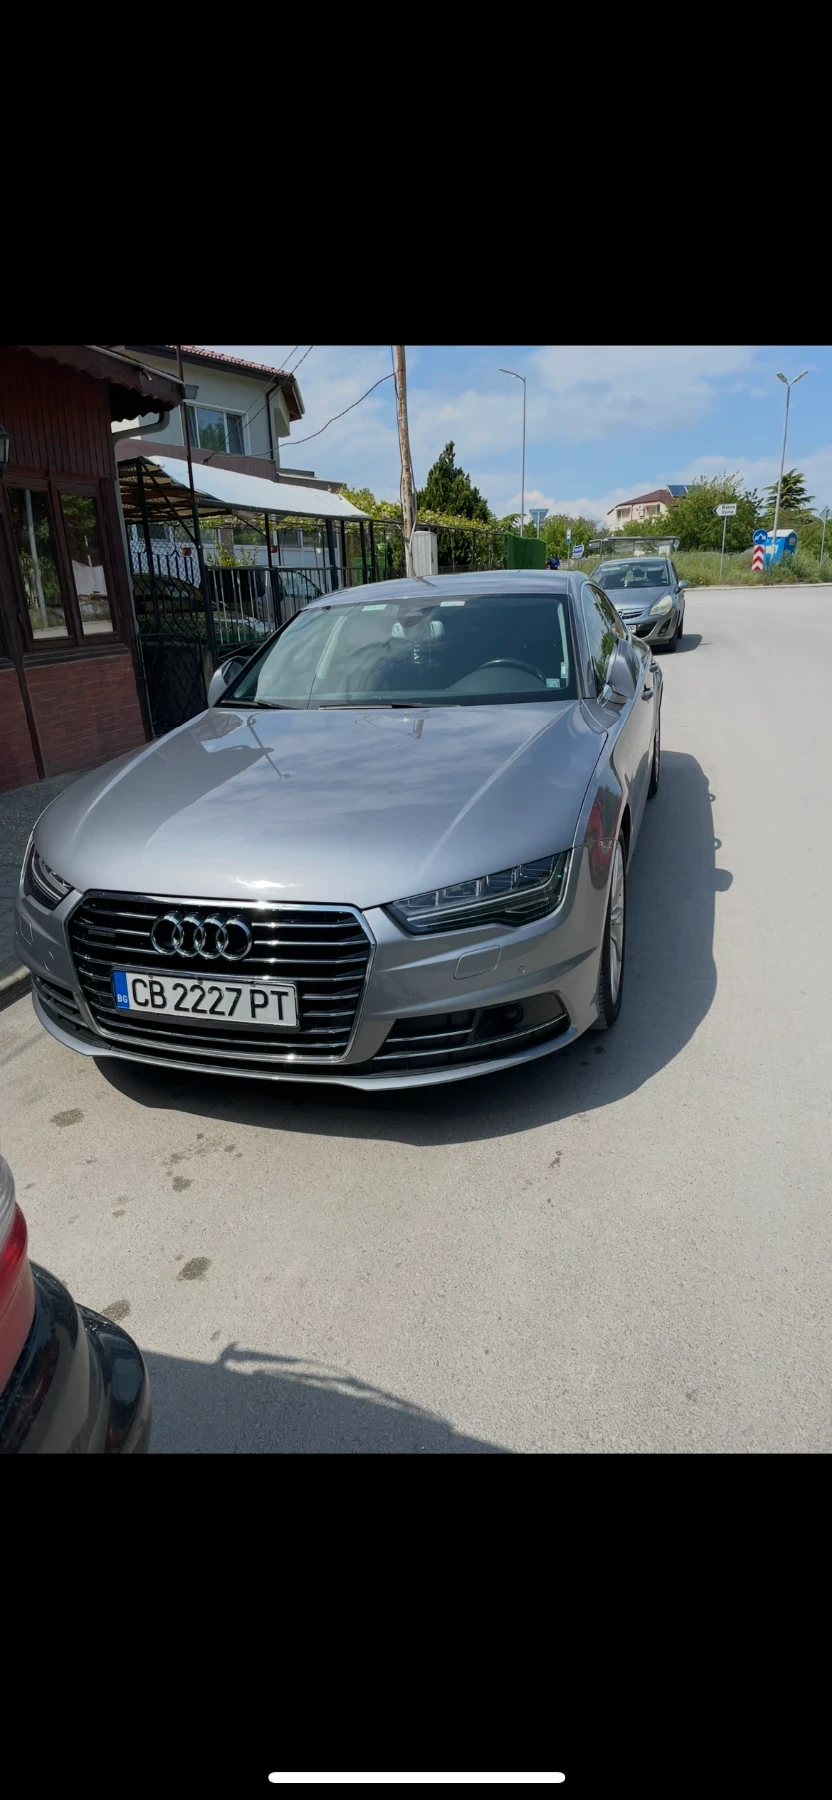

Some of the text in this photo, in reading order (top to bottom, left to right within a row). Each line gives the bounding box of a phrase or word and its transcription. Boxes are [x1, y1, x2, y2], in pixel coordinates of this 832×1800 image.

[117, 994, 128, 1004] BG
[131, 978, 289, 1020] CB 2227 PT
